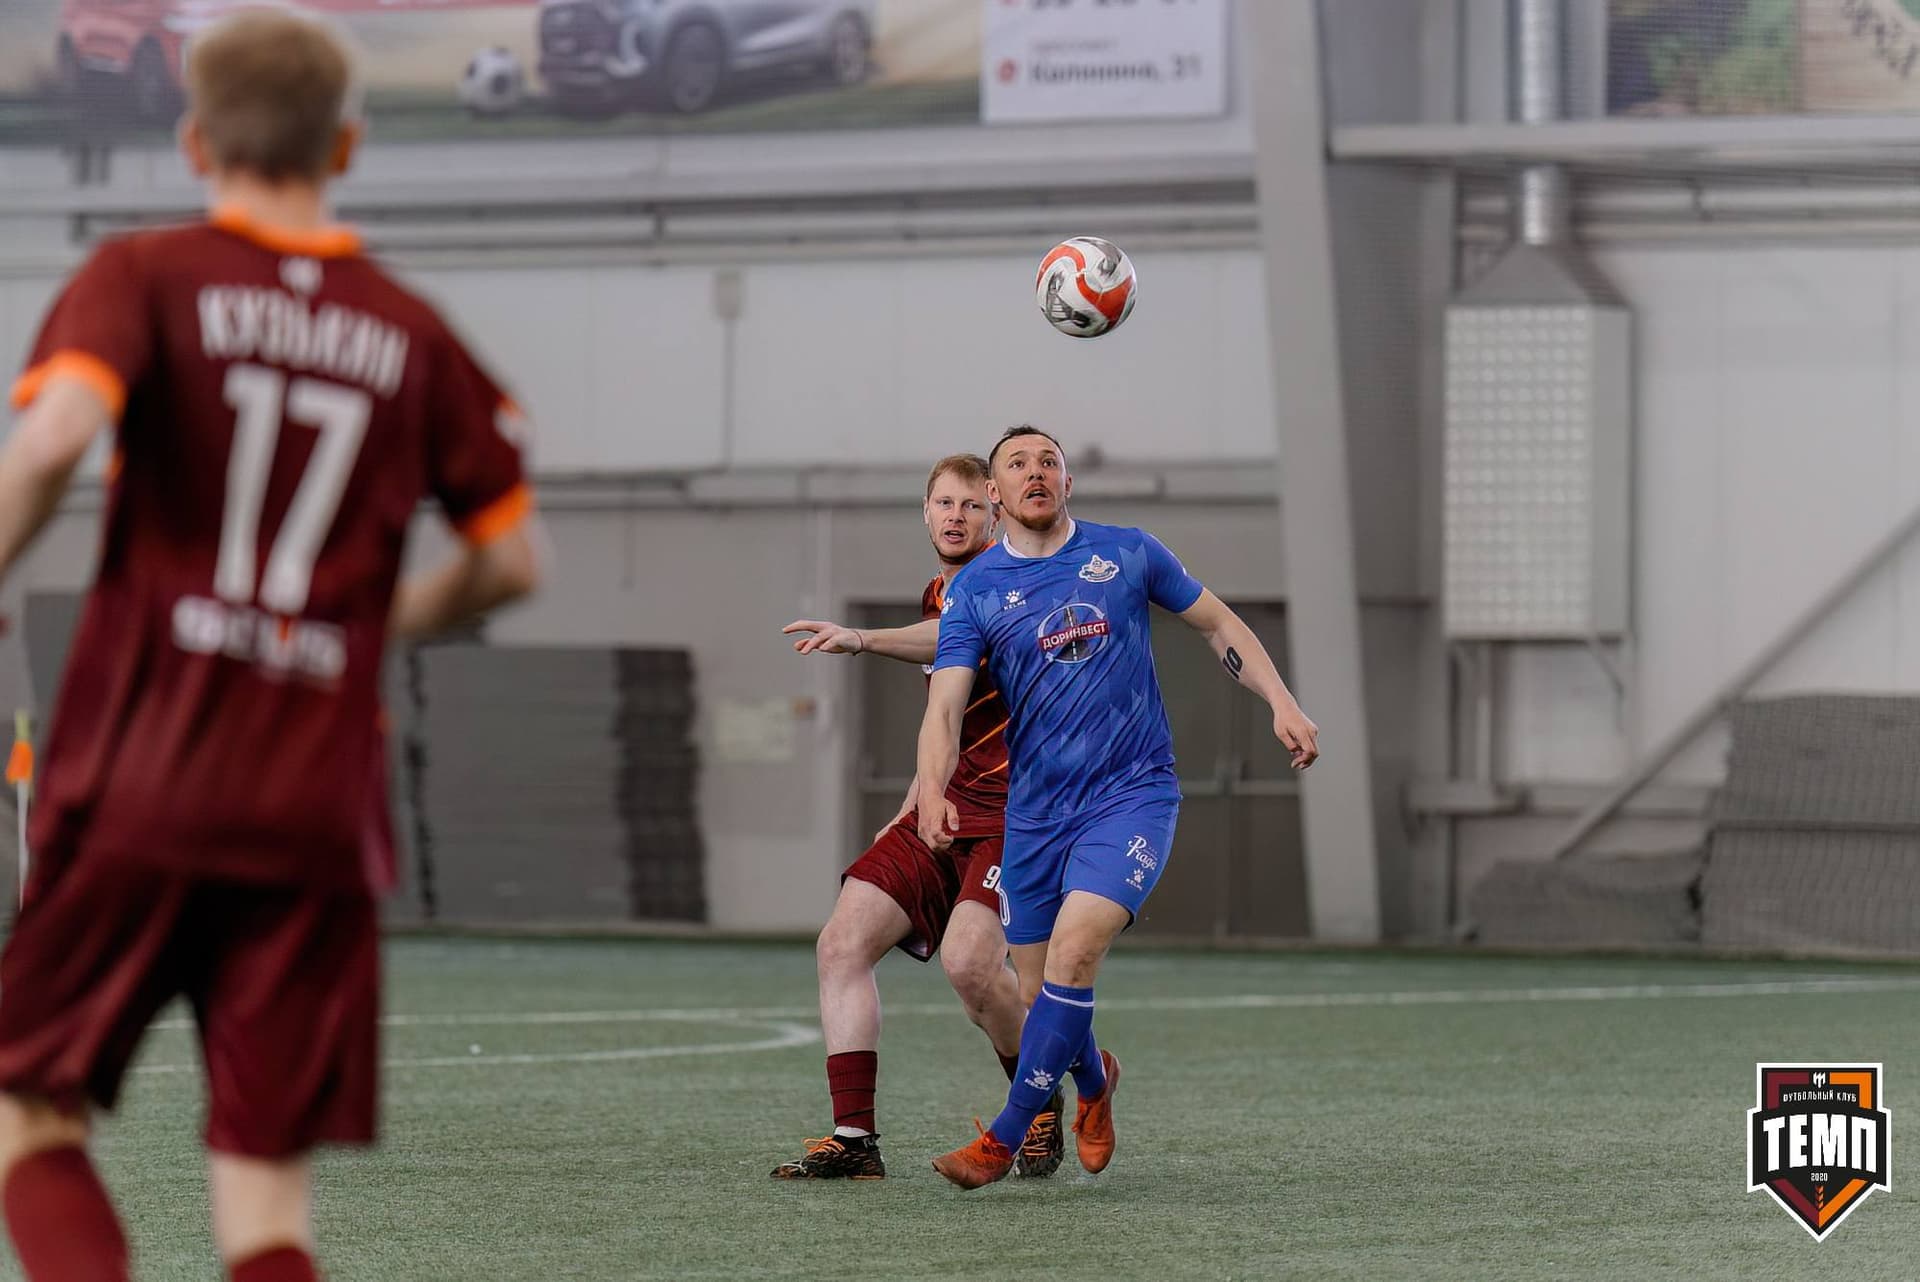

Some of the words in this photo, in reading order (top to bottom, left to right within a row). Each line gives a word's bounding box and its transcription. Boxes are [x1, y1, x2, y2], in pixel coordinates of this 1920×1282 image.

[213, 363, 373, 614] 17
[1042, 622, 1106, 650] ДОРИНВЕСТ
[982, 865, 1001, 894] 9
